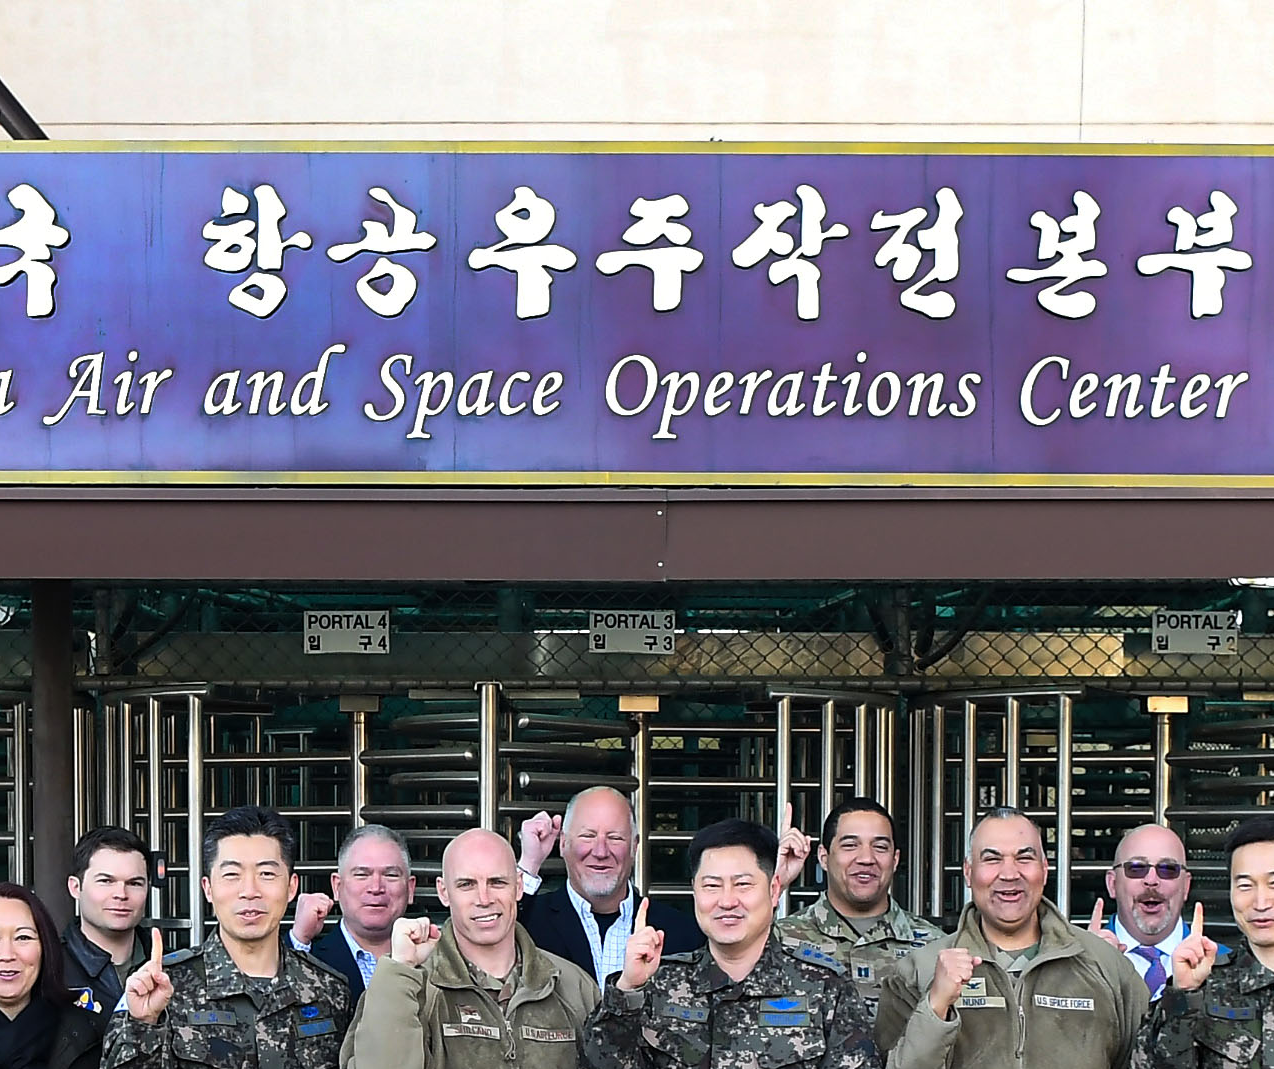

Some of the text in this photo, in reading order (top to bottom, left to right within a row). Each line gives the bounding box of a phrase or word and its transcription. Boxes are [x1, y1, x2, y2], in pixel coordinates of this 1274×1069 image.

[201, 184, 1253, 321] 항공우주작전본부
[42, 350, 173, 426] Air
[204, 344, 348, 415] and
[365, 353, 563, 439] Space
[604, 350, 982, 439] Operations
[1019, 355, 1250, 427] Center
[307, 613, 388, 630] PORTAL 4
[592, 612, 674, 630] PORTAL 3
[1156, 614, 1236, 630] PORTAL 2
[377, 635, 388, 651] 4
[663, 635, 674, 651] 3
[1226, 635, 1236, 652] 2
[1049, 999, 1070, 1008] SPACE
[1070, 1000, 1091, 1009] FORCE
